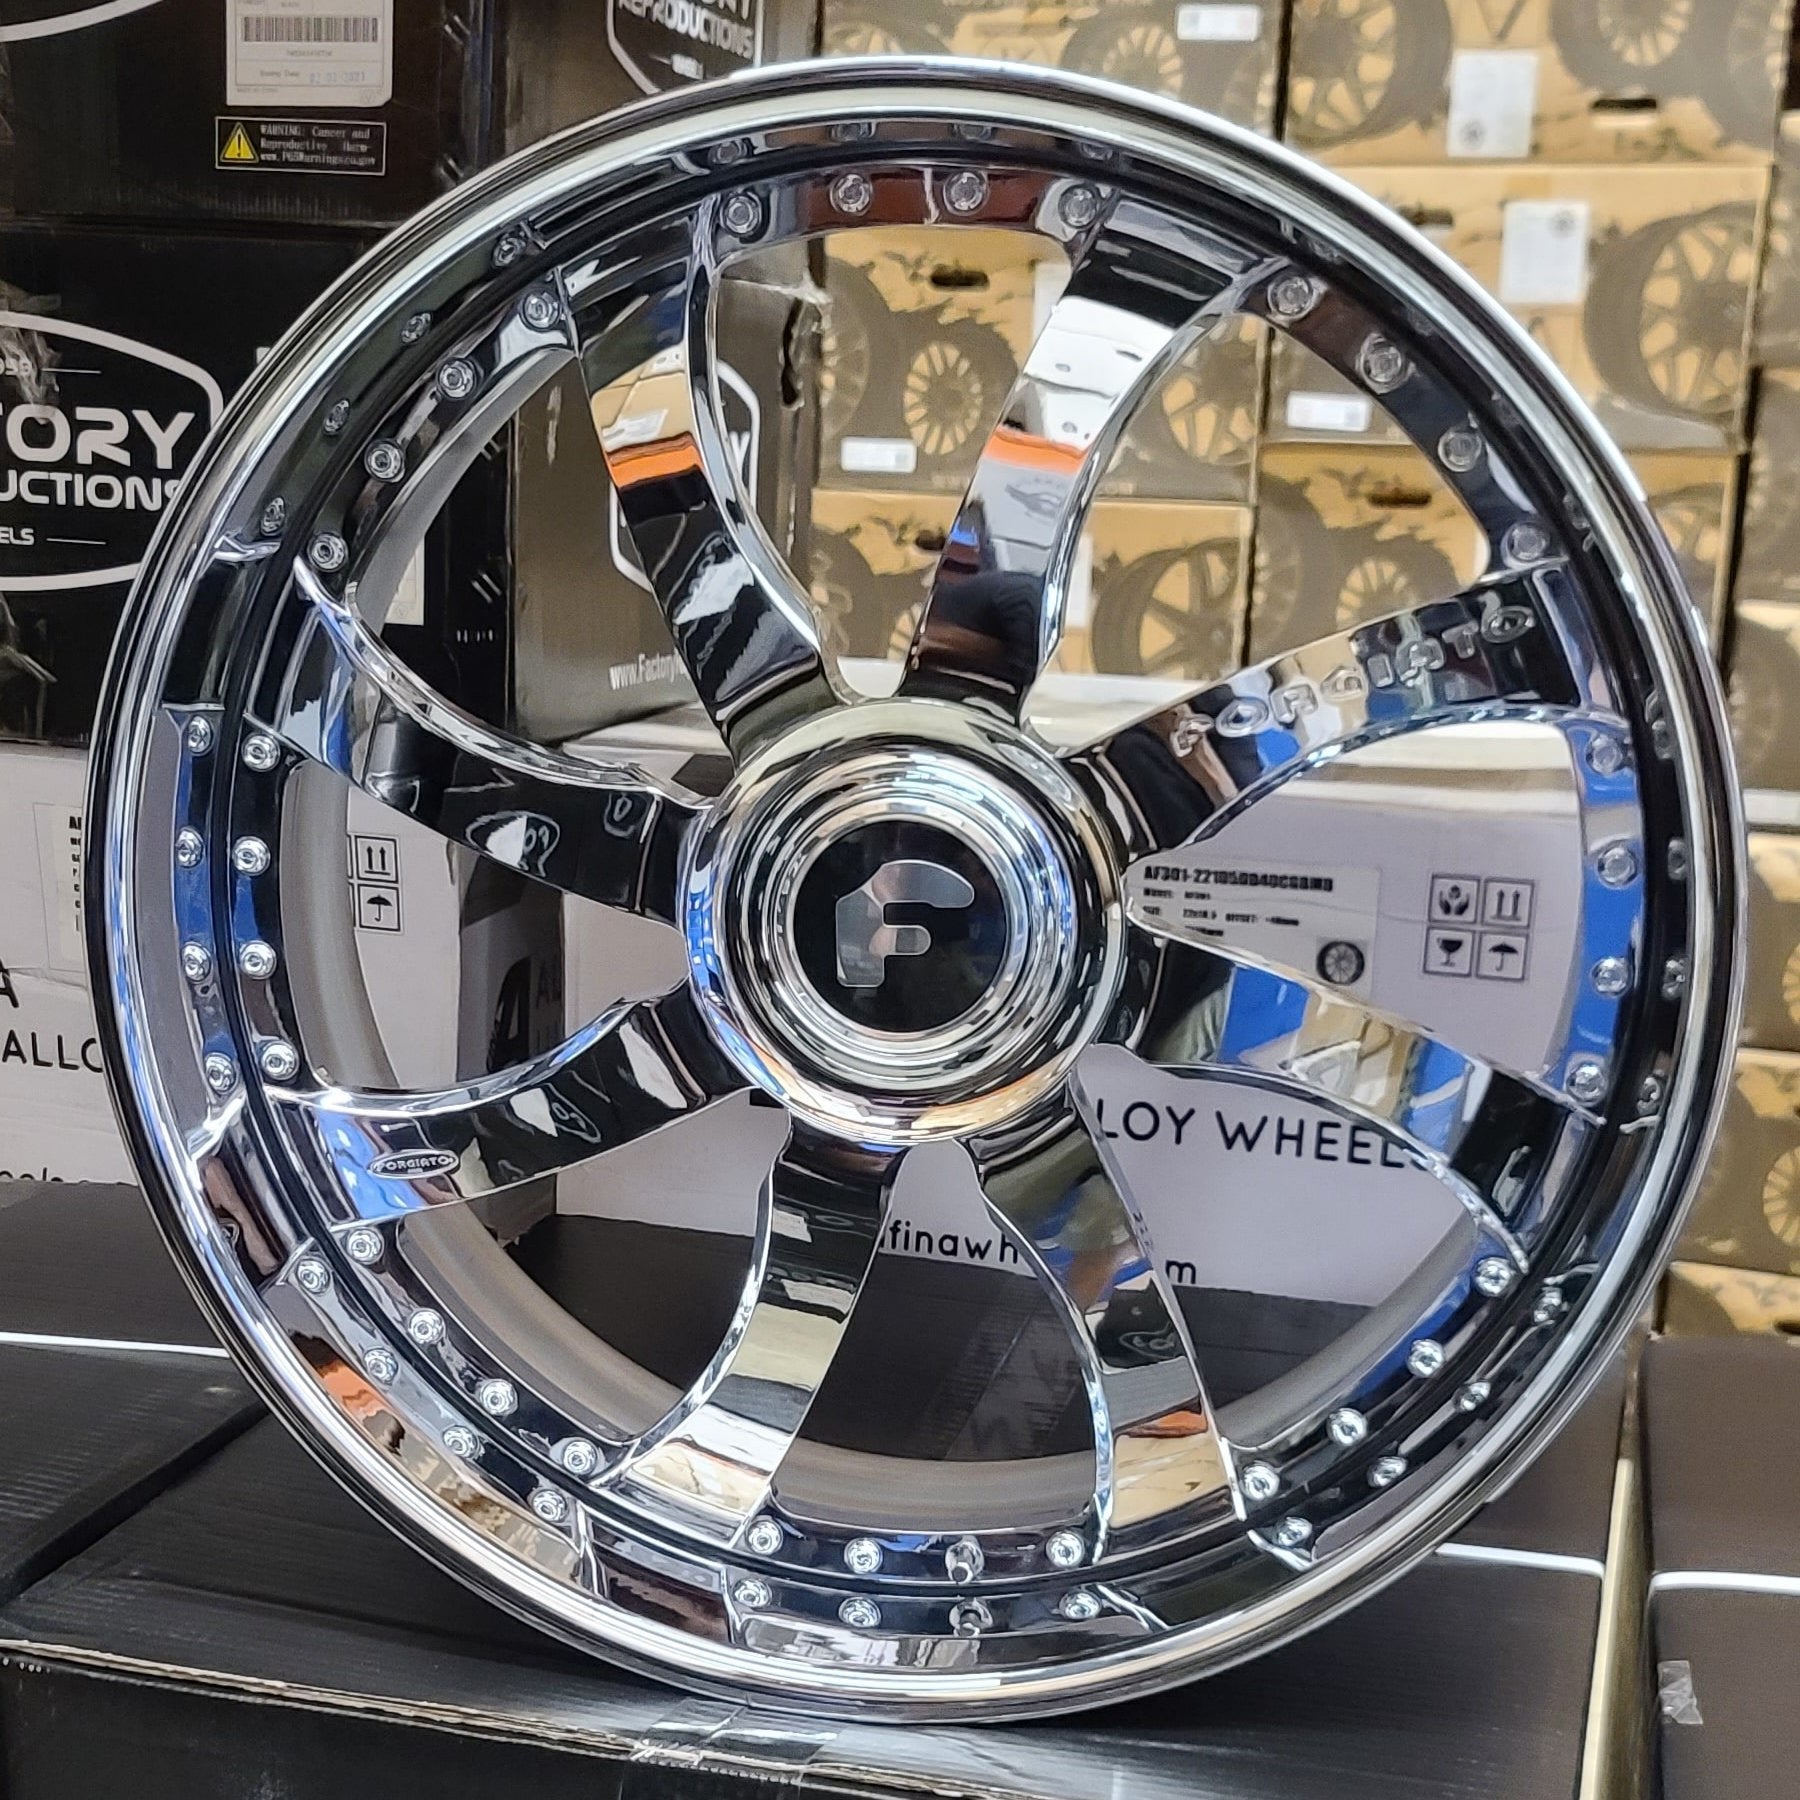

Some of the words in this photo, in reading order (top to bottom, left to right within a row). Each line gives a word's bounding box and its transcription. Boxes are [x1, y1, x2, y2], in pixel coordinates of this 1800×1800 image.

[312, 126, 346, 138] Cancer
[351, 128, 370, 139] and
[1215, 1110, 1428, 1171] WHEEL
[376, 1155, 451, 1172] FORGIATO
